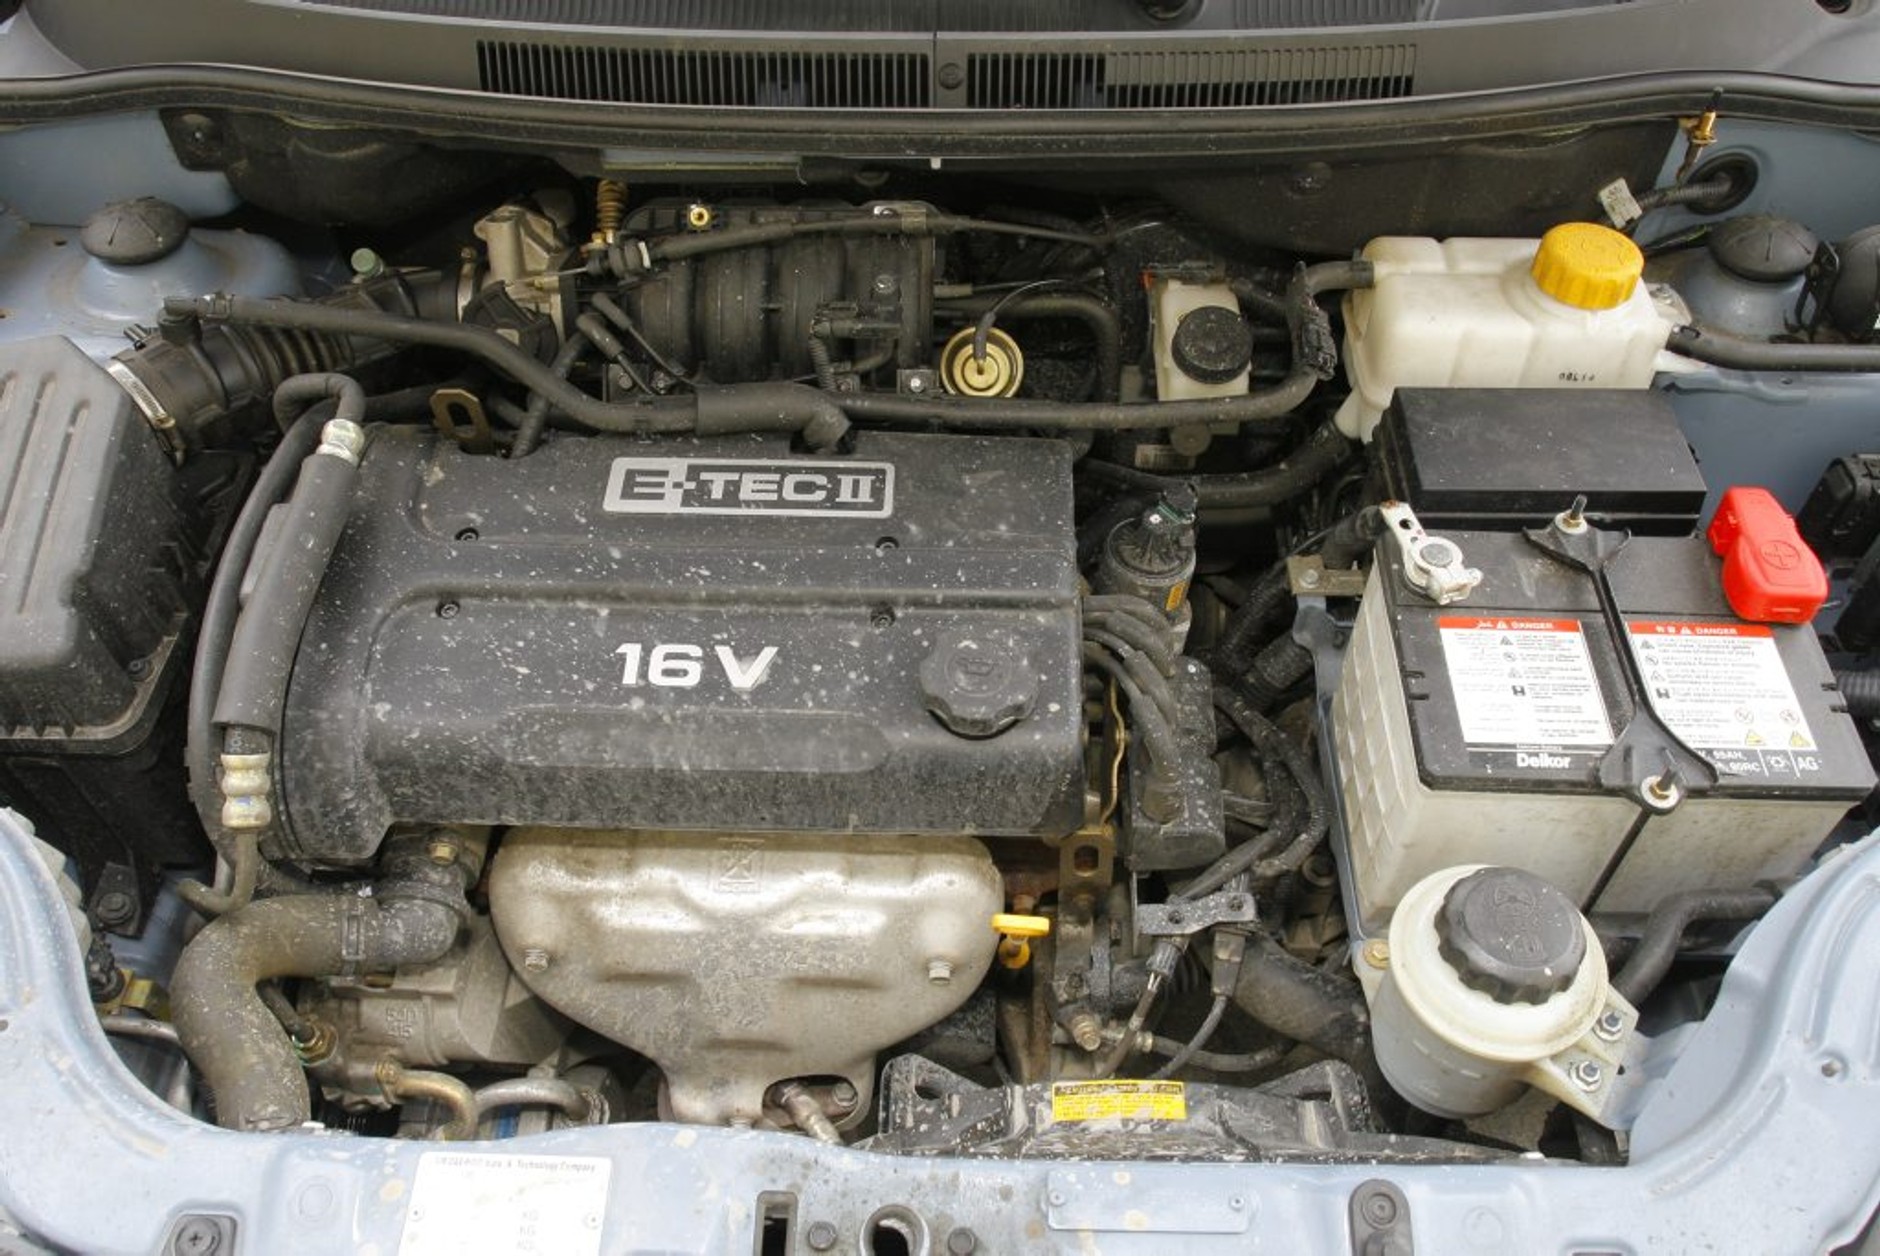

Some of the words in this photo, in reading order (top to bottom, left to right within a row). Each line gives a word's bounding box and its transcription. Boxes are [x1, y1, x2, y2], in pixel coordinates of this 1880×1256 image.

[1510, 621, 1554, 631] DANGER
[1694, 626, 1738, 636] DANGER
[615, 642, 780, 689] 16V
[1516, 752, 1571, 769] Delkor
